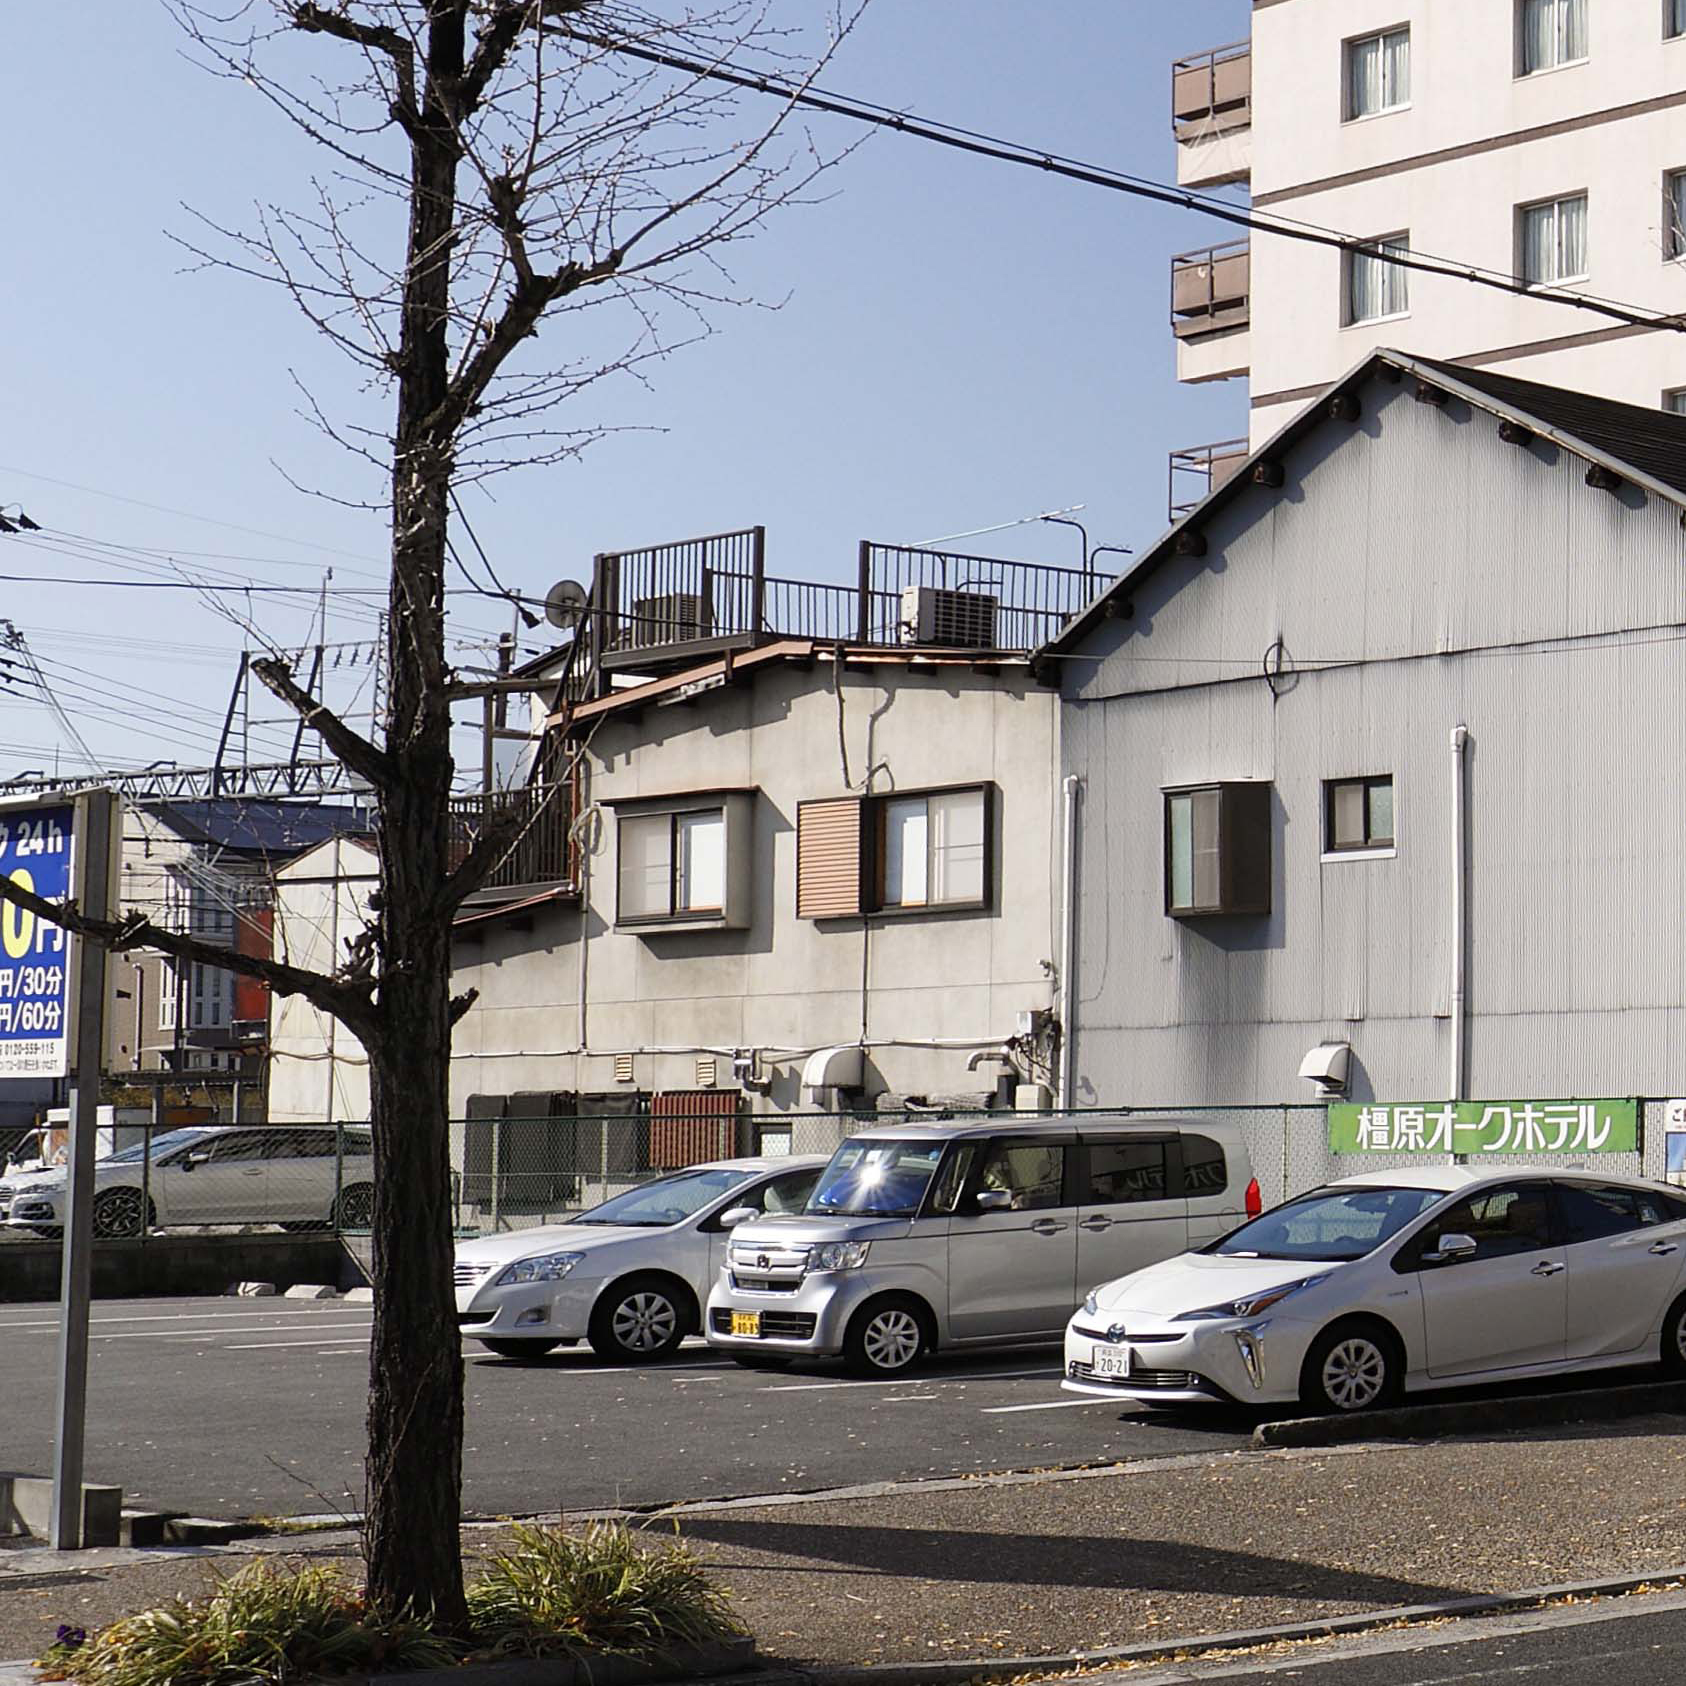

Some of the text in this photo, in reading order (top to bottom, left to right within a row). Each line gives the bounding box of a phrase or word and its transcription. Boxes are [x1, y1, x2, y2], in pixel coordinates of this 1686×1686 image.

[16, 819, 63, 856] 24h
[1356, 1103, 1612, 1151] 橿原オークホテル
